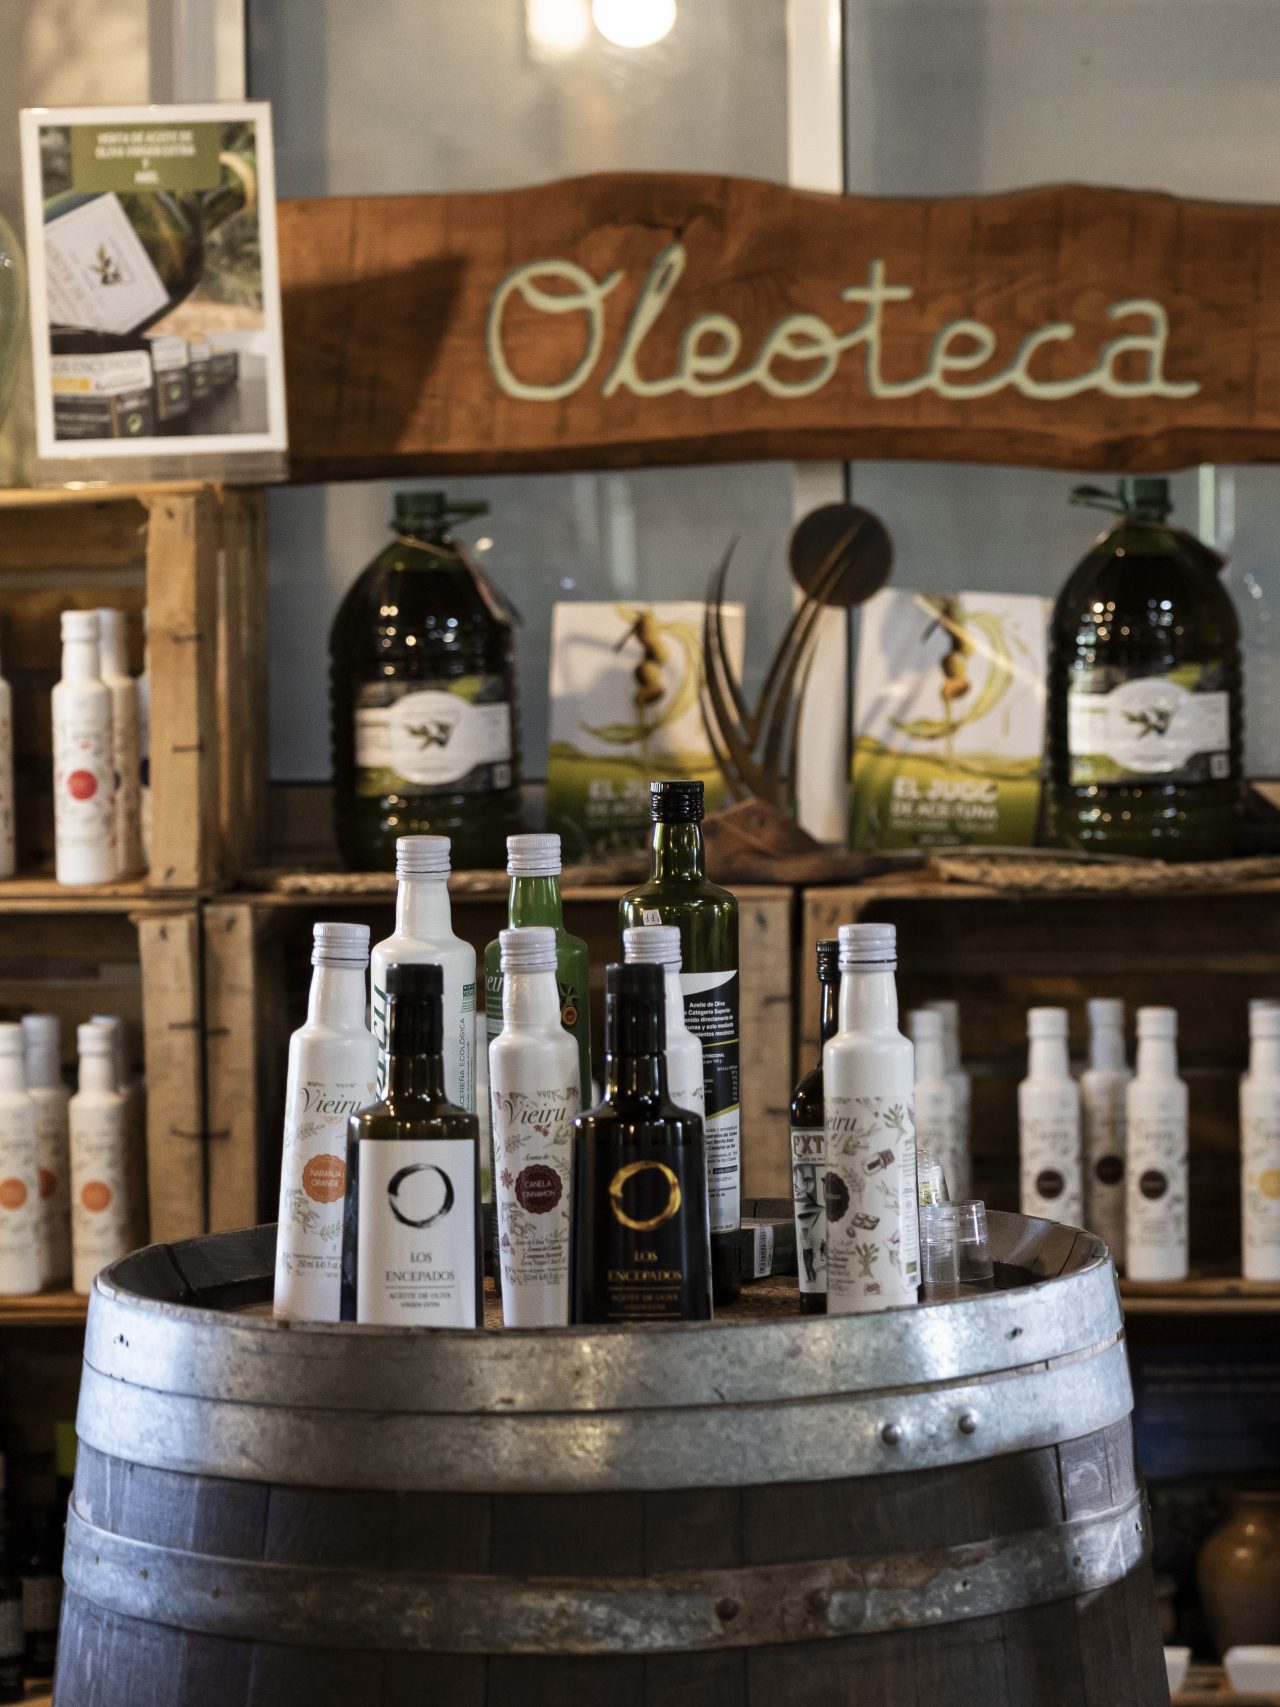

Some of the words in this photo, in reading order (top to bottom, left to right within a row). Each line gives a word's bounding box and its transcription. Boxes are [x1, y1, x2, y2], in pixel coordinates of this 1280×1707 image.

[487, 243, 1202, 402] Oleoteca
[892, 775, 919, 799] EL
[300, 1086, 362, 1115] Vieiru
[503, 1099, 567, 1126] Vieiru
[310, 1168, 342, 1178] NARANJA
[523, 1180, 552, 1188] CANELA
[522, 1189, 556, 1198] CINNAMON
[410, 1251, 433, 1263] LOS
[634, 1251, 658, 1262] LOS
[384, 1270, 455, 1282] ENCEPADOS
[607, 1270, 682, 1281] ENCEPADOS
